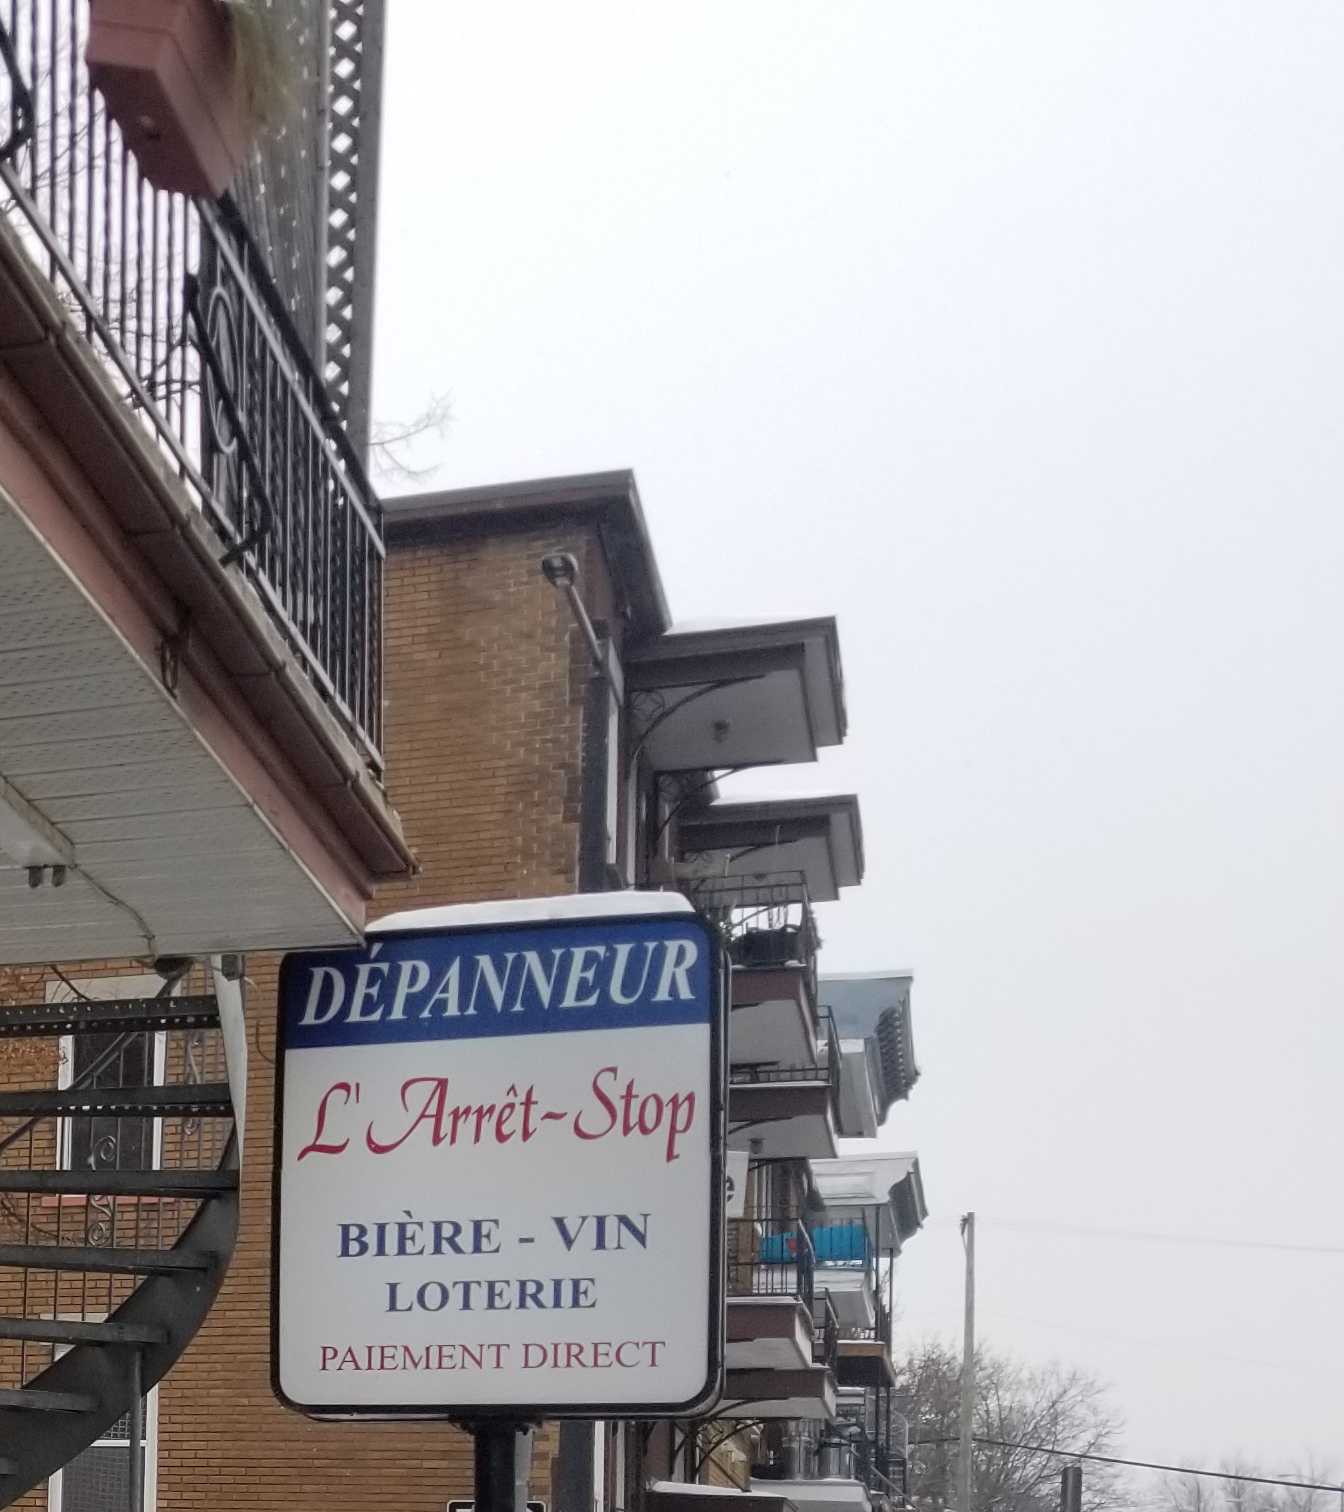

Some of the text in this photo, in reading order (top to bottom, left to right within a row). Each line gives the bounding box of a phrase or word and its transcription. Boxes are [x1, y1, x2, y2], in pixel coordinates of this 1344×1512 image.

[298, 939, 699, 1026] DÉPANNEUR
[337, 1211, 501, 1258] BIÈRE
[552, 1213, 651, 1252] VIN
[385, 1277, 597, 1313] LOTERIE
[319, 1340, 666, 1371] PAIEMENT DIRECT
